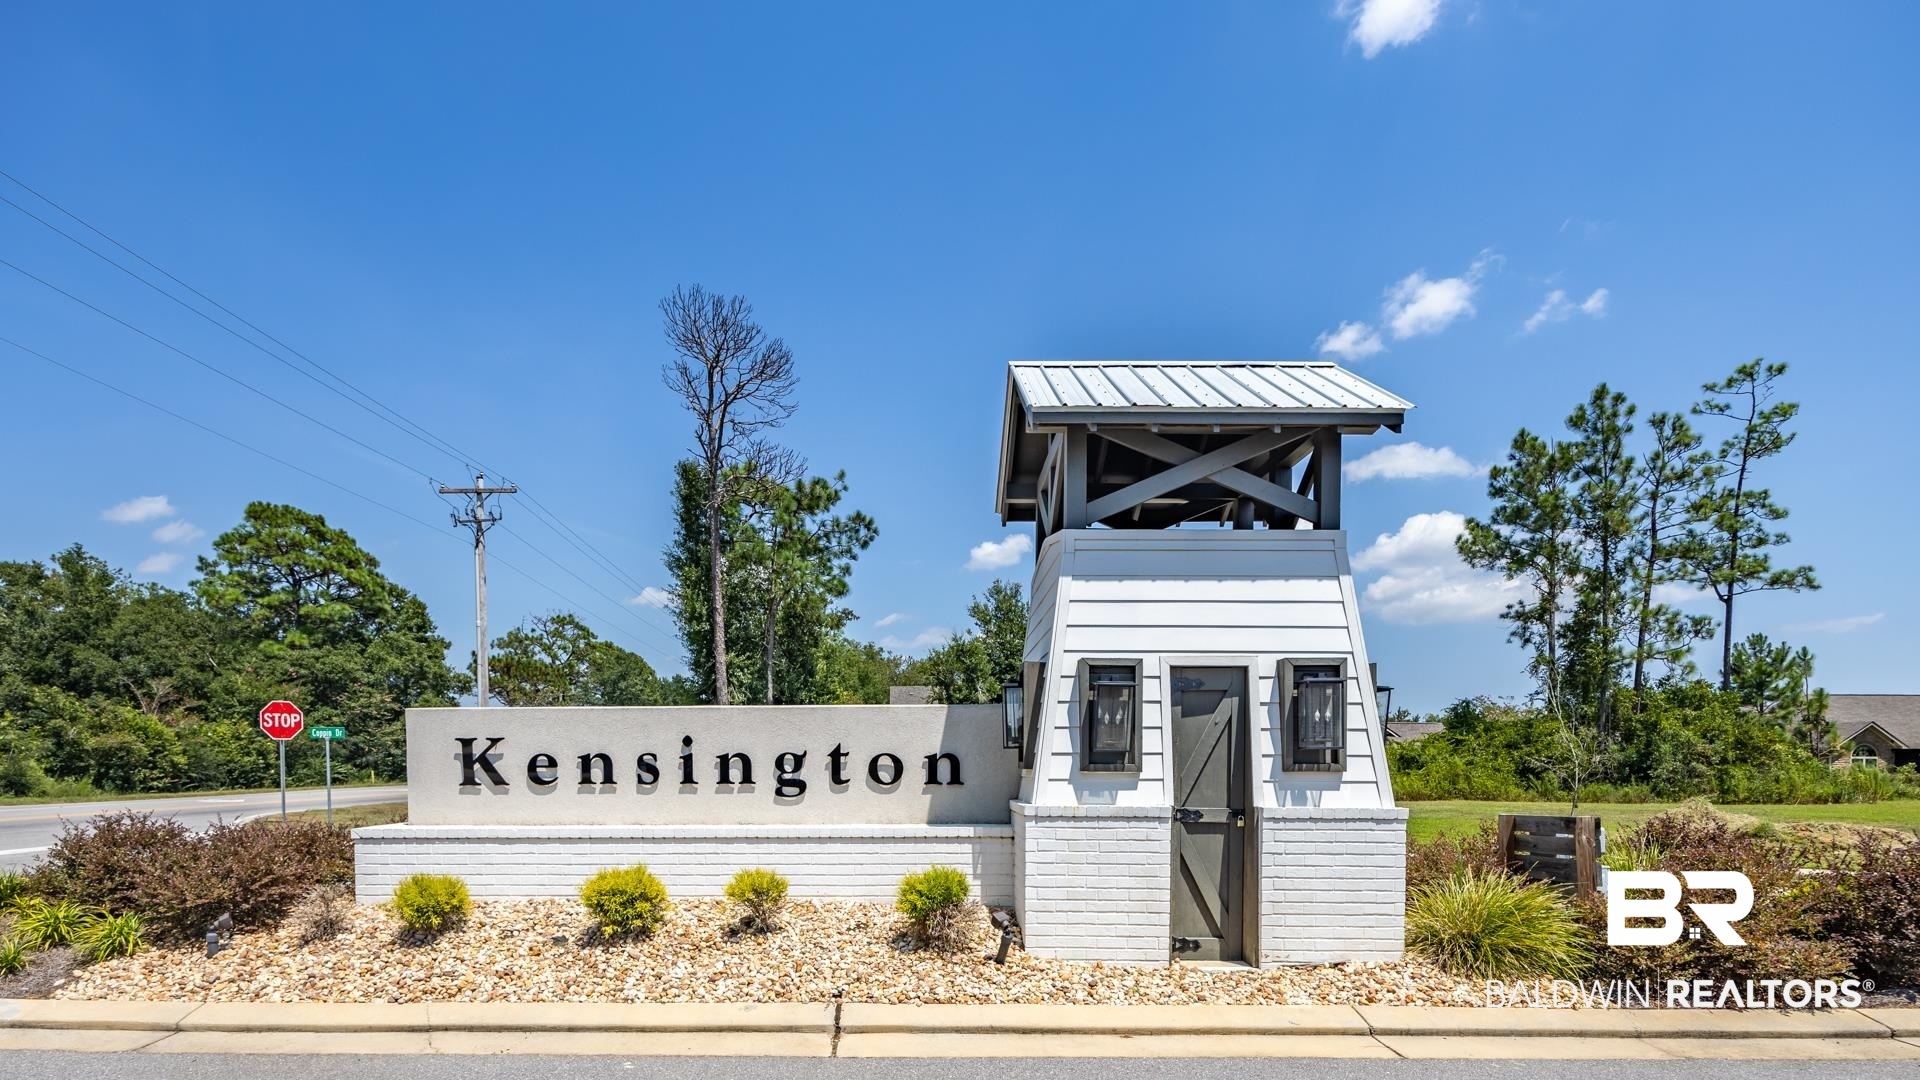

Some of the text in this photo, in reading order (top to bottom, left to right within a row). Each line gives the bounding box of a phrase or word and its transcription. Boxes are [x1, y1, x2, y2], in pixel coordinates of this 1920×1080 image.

[263, 713, 300, 728] STOP
[336, 729, 343, 737] Dr
[455, 735, 965, 798] Kensington
